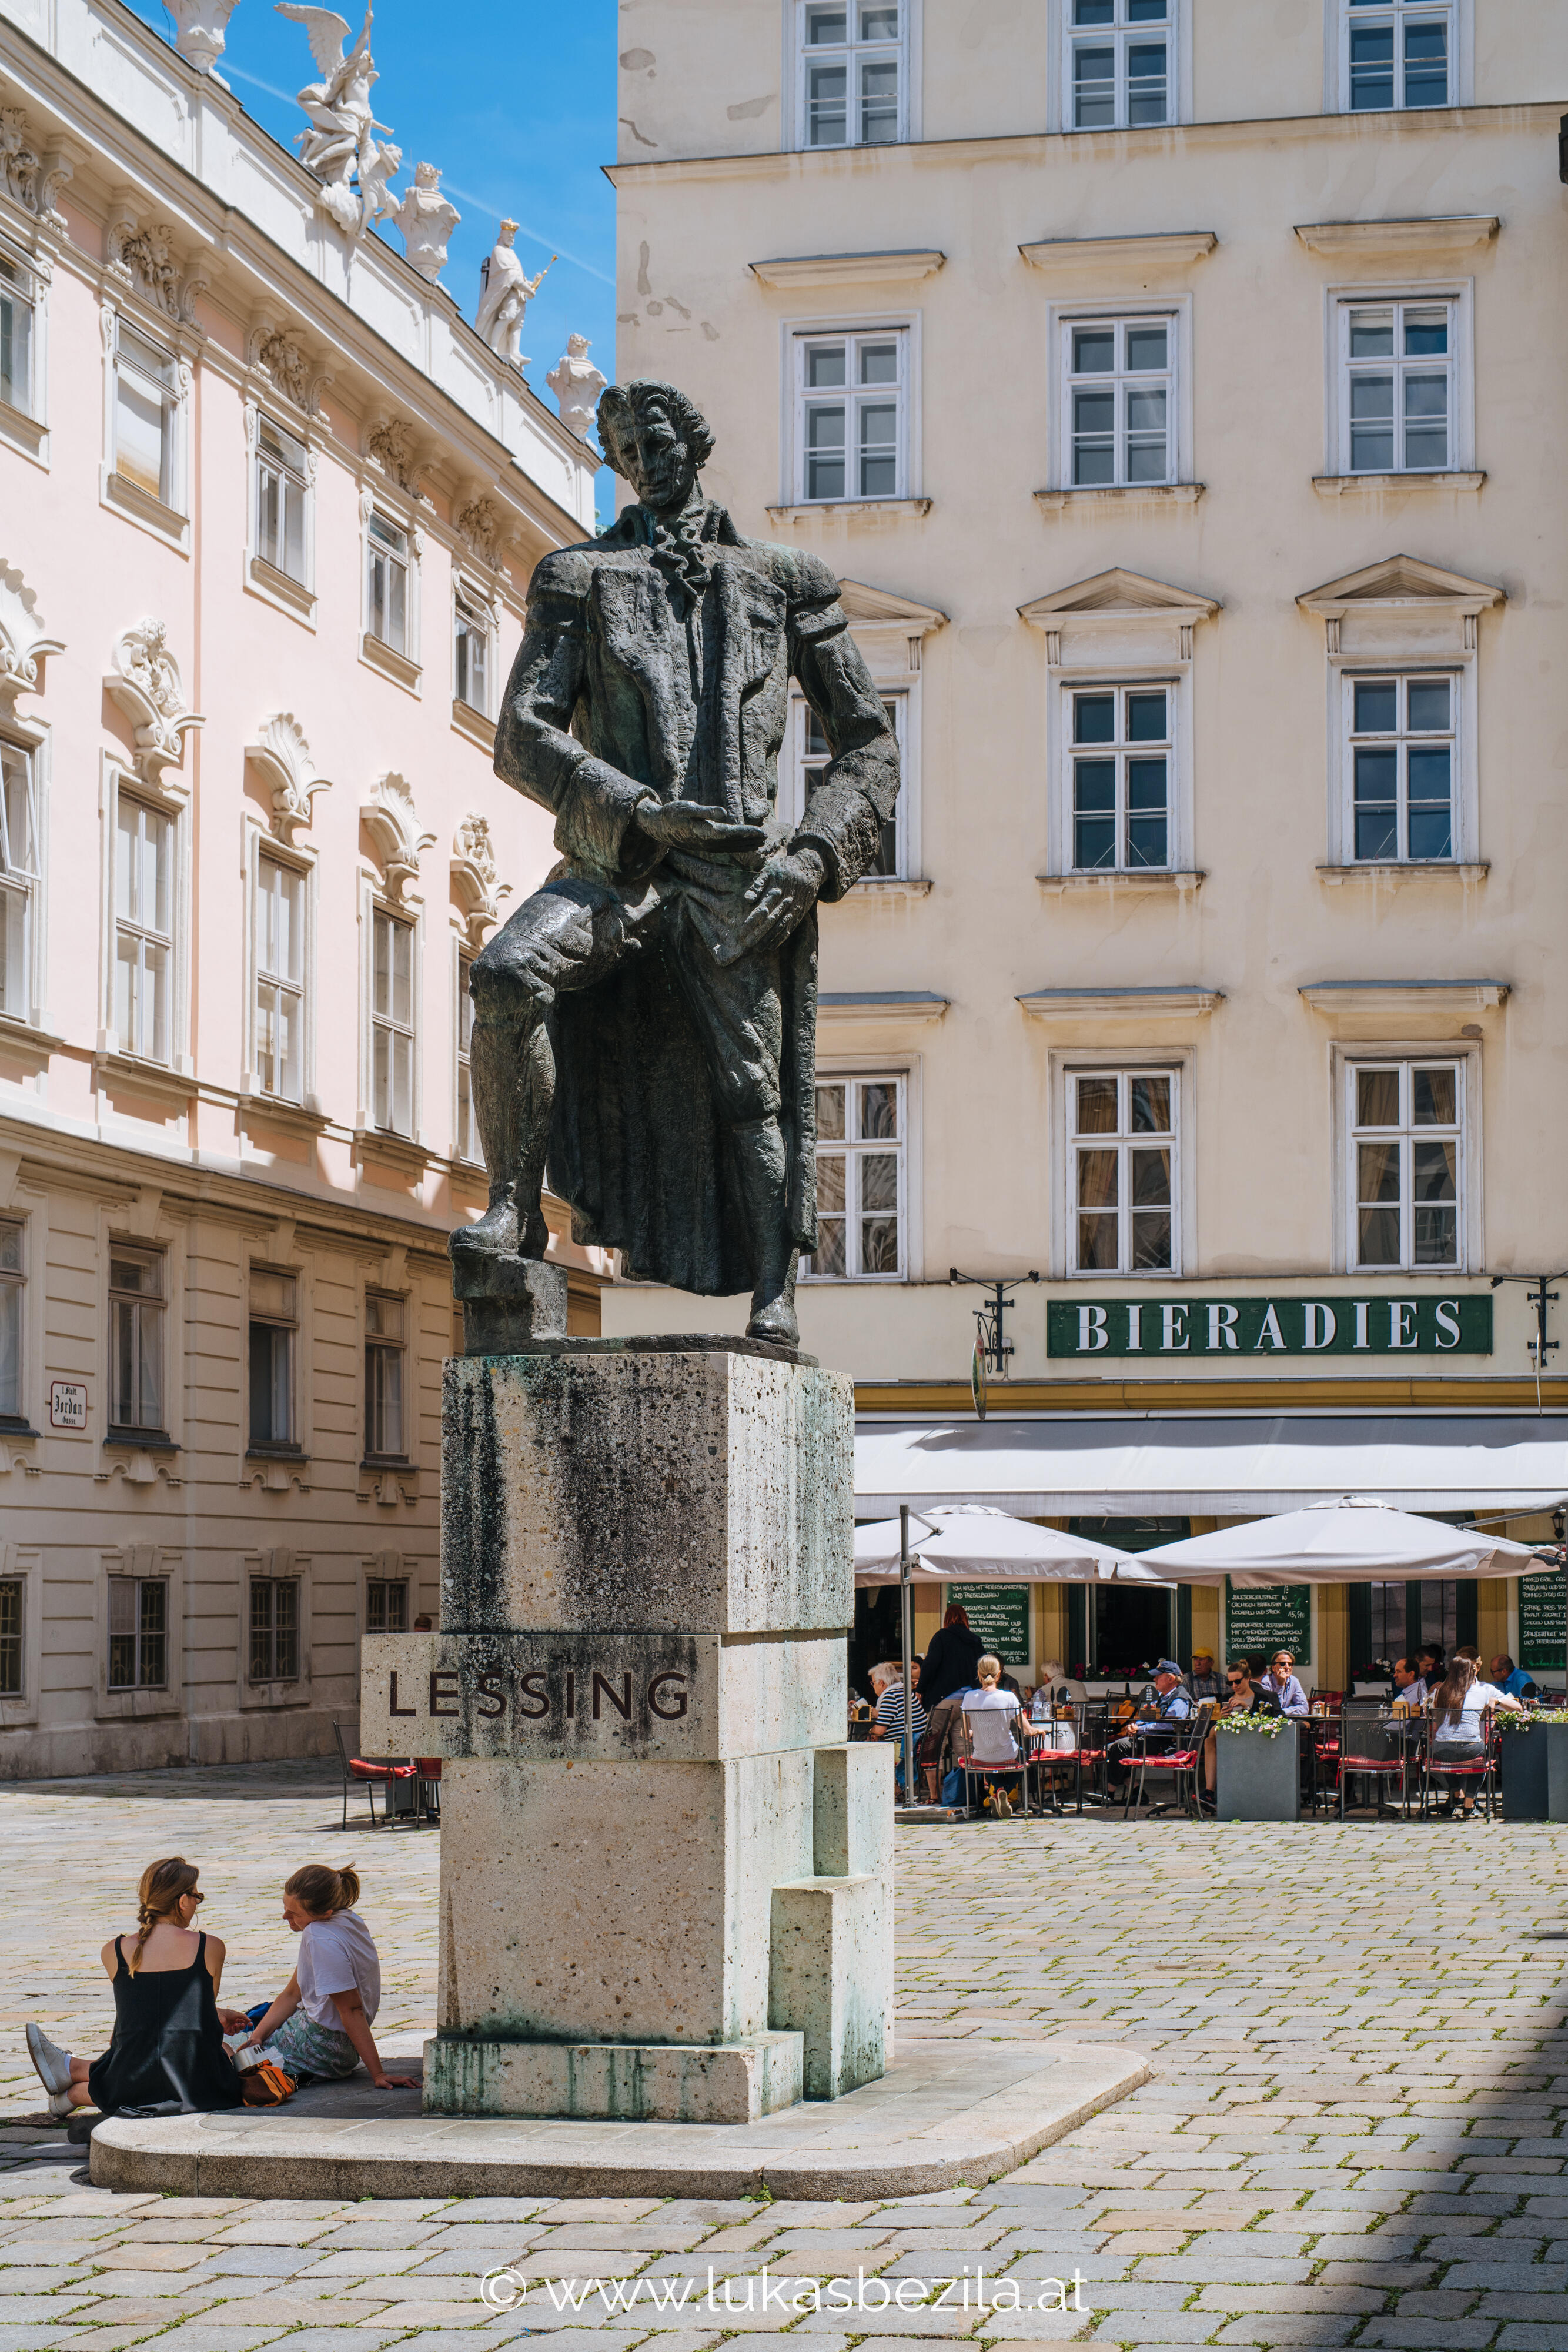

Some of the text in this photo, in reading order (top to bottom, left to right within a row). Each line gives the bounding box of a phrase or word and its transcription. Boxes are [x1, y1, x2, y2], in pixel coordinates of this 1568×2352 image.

[1075, 1301, 1462, 1351] BIERADIES
[54, 1395, 82, 1415] Jordan
[390, 1671, 687, 1720] LESSING
